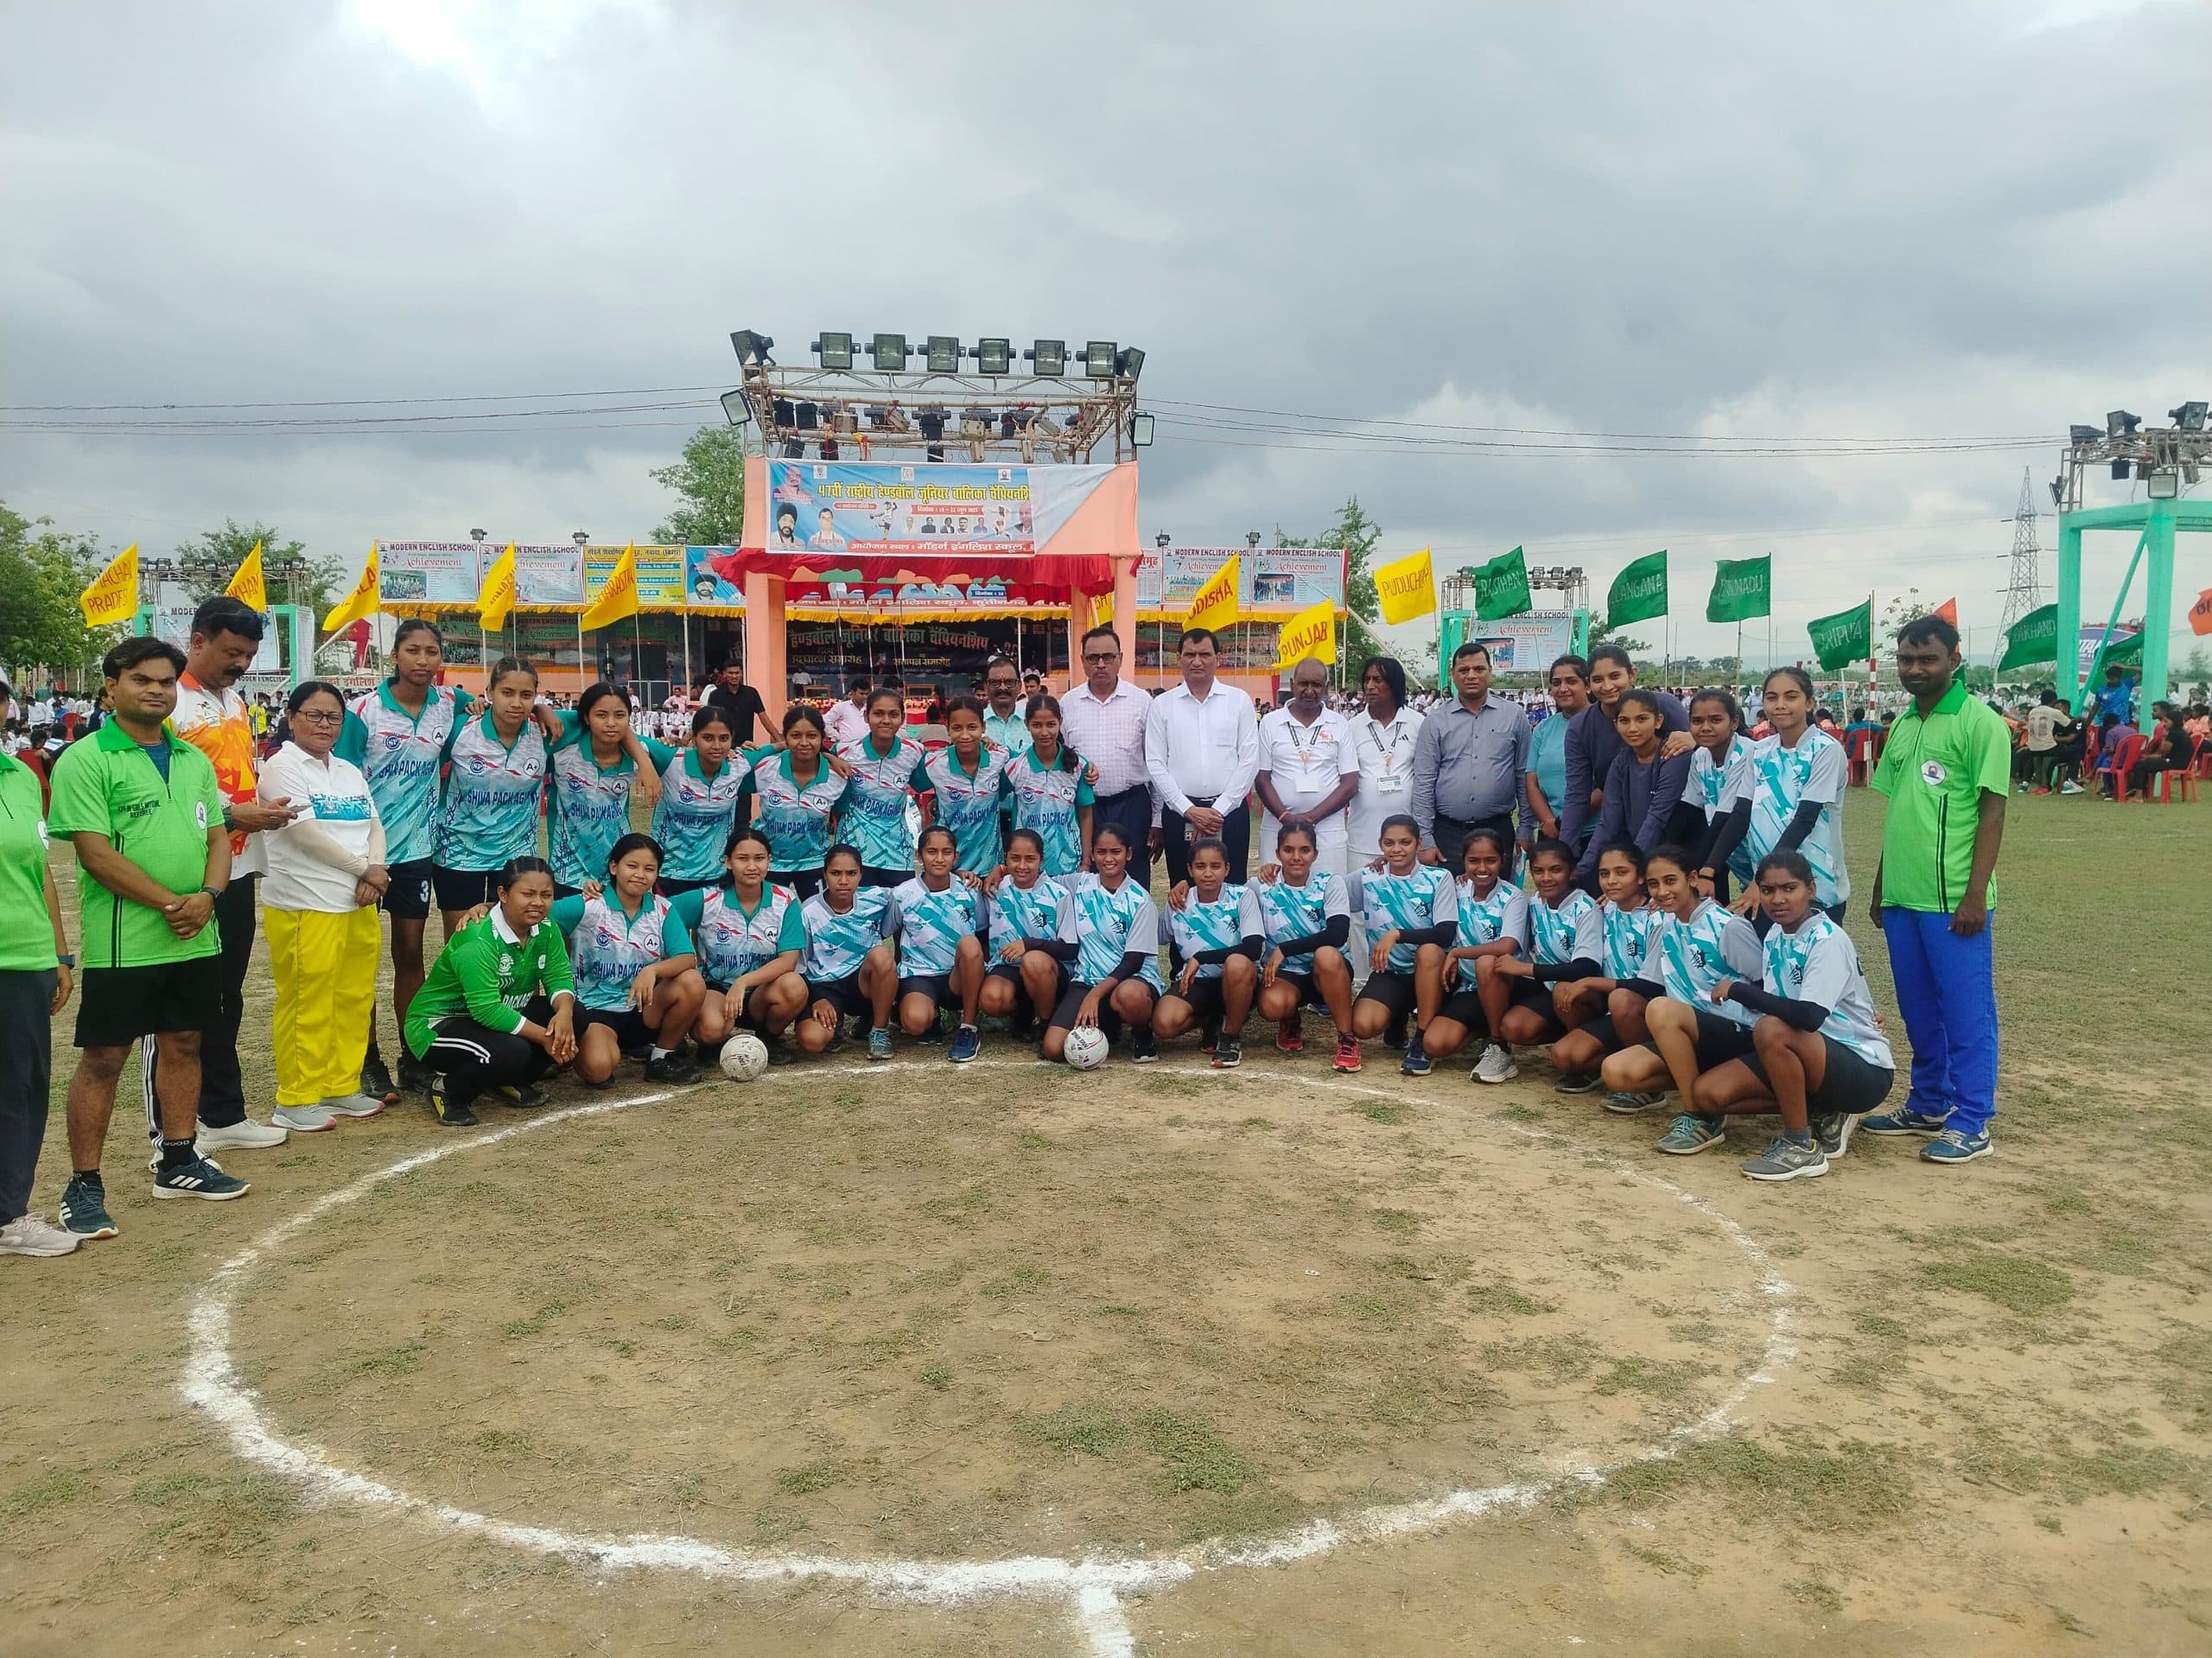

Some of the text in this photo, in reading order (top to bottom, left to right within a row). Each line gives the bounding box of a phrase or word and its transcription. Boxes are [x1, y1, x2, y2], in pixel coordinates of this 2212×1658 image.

[917, 483, 950, 505] जूनियर
[951, 483, 987, 500] बालिका
[390, 543, 475, 552] MODERN ENGLISH SCHOOL
[494, 545, 579, 554] MODN ENGLISH SCHOOL
[403, 557, 462, 569] Achievement
[515, 560, 566, 570] chievement
[1274, 562, 1327, 572] Achievement
[1544, 611, 1569, 619] SCHOOL
[1281, 620, 1328, 663] PUNJAB
[525, 761, 537, 772] A+
[895, 776, 906, 785] A+
[467, 789, 490, 806] SHIVA
[420, 880, 429, 903] 3
[646, 937, 658, 947] A+
[716, 953, 738, 969] SHIVA
[593, 962, 617, 978] SHIVA
